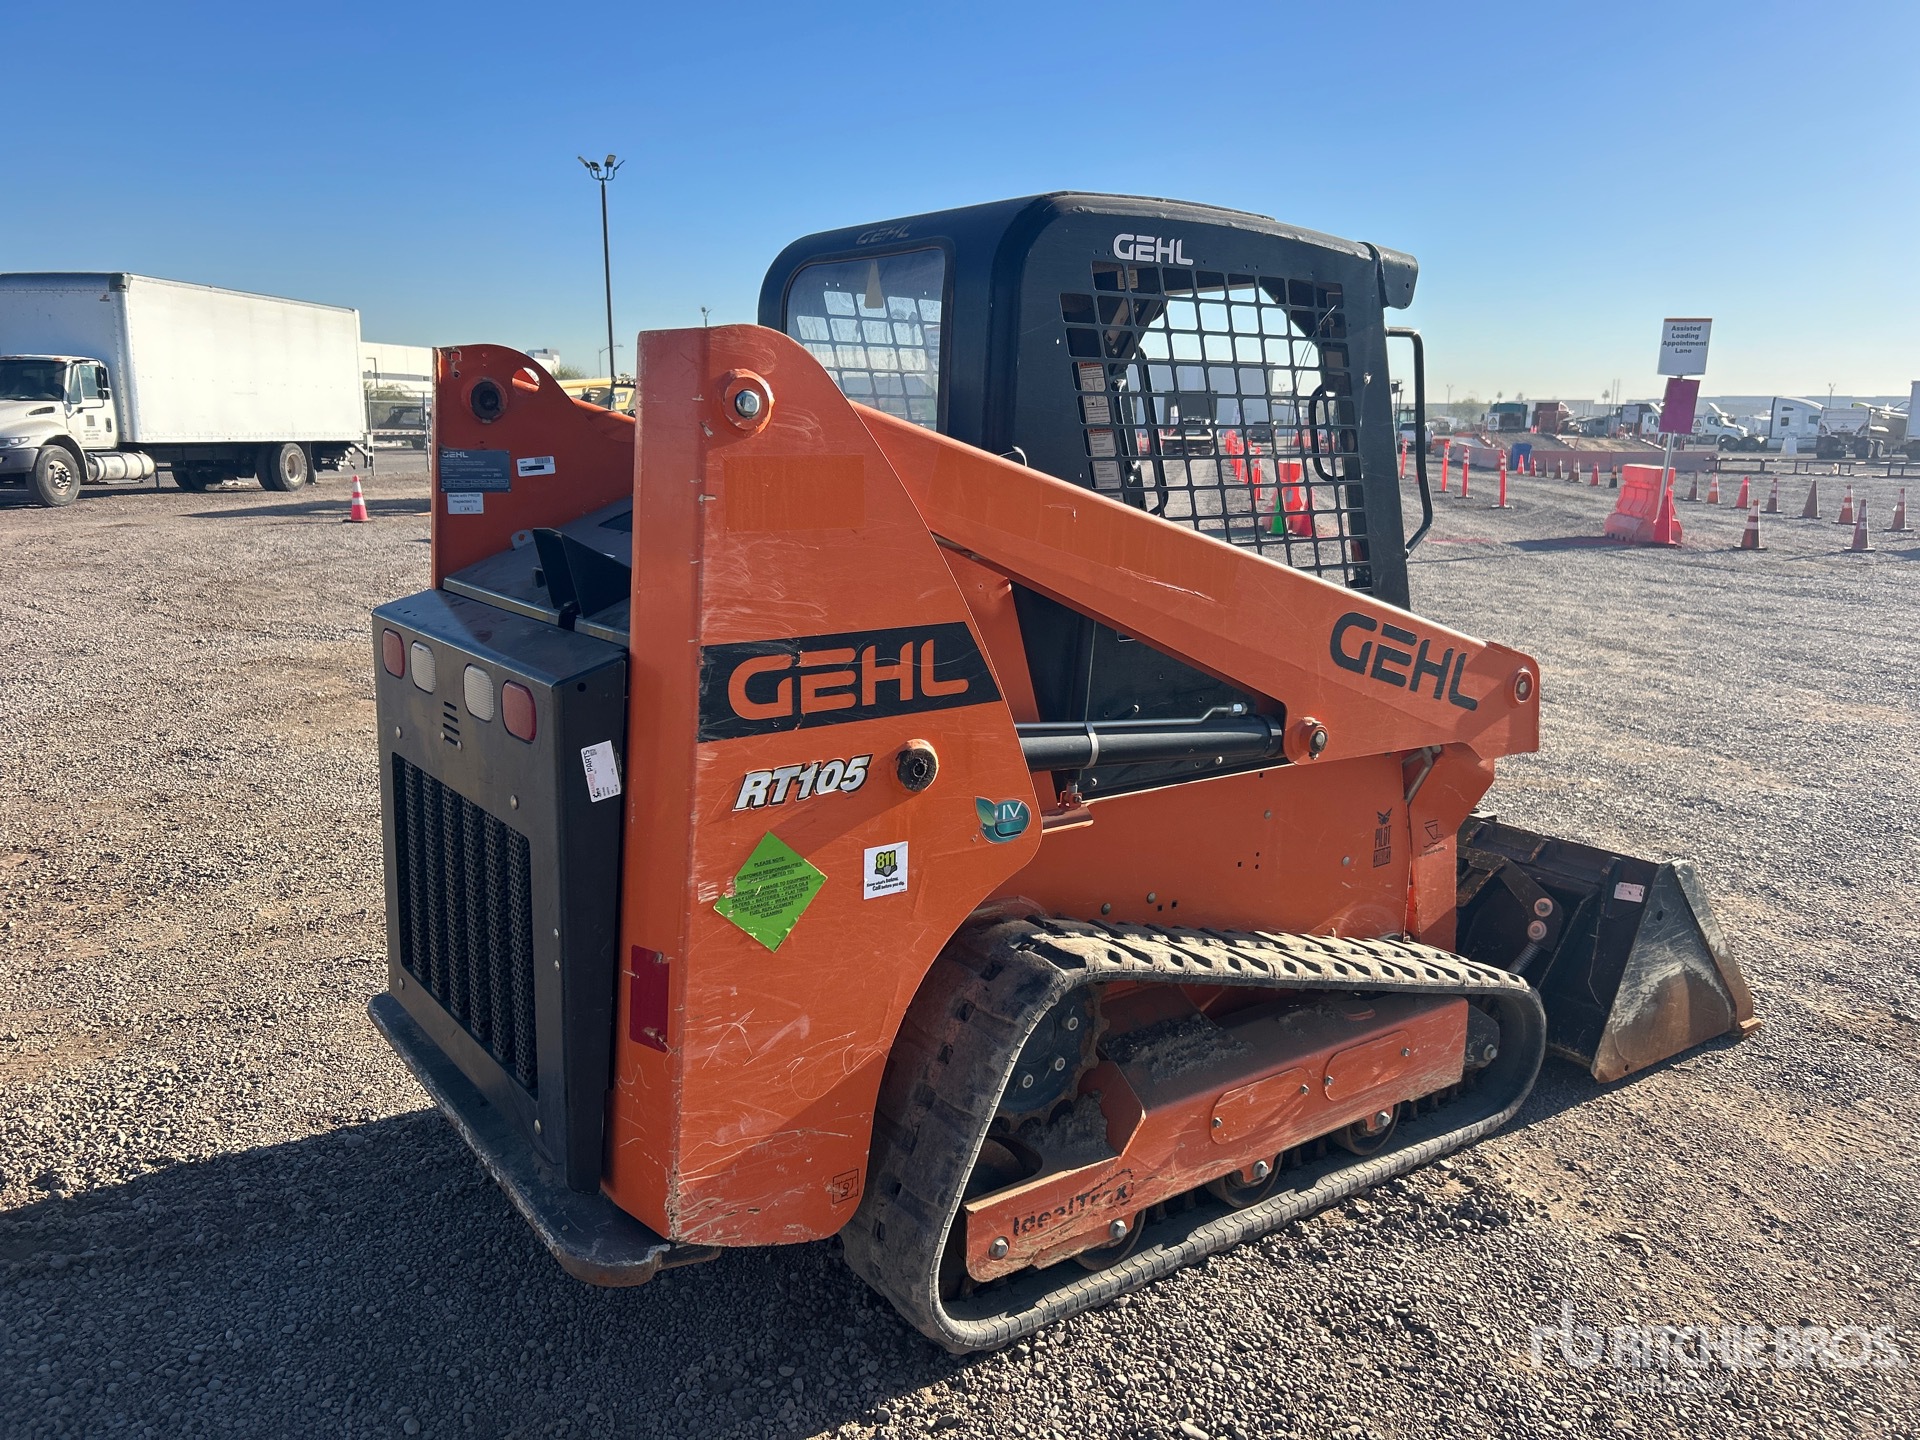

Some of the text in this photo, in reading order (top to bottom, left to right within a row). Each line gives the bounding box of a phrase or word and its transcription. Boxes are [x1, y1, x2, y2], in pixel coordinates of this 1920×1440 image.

[855, 224, 911, 245] GEHL
[1113, 233, 1194, 266] GEHL
[1330, 611, 1478, 711] GEHL
[727, 639, 969, 721] GEHL
[583, 750, 593, 772] PARTS
[733, 754, 873, 812] RT105
[1002, 801, 1023, 820] IV
[754, 859, 771, 868] PLEASE
[876, 850, 896, 869] 811
[737, 871, 762, 881] CUSTOMER
[761, 882, 779, 892] DAMAGE
[787, 875, 811, 885] EQUIPMENT
[770, 871, 786, 879] LIMITED
[783, 882, 798, 890] CHECK
[751, 901, 770, 910] DAMAGE
[756, 893, 780, 904] BATTERIES
[750, 901, 794, 916] FUEL REPLACEMENT
[761, 909, 783, 919] CLEANING
